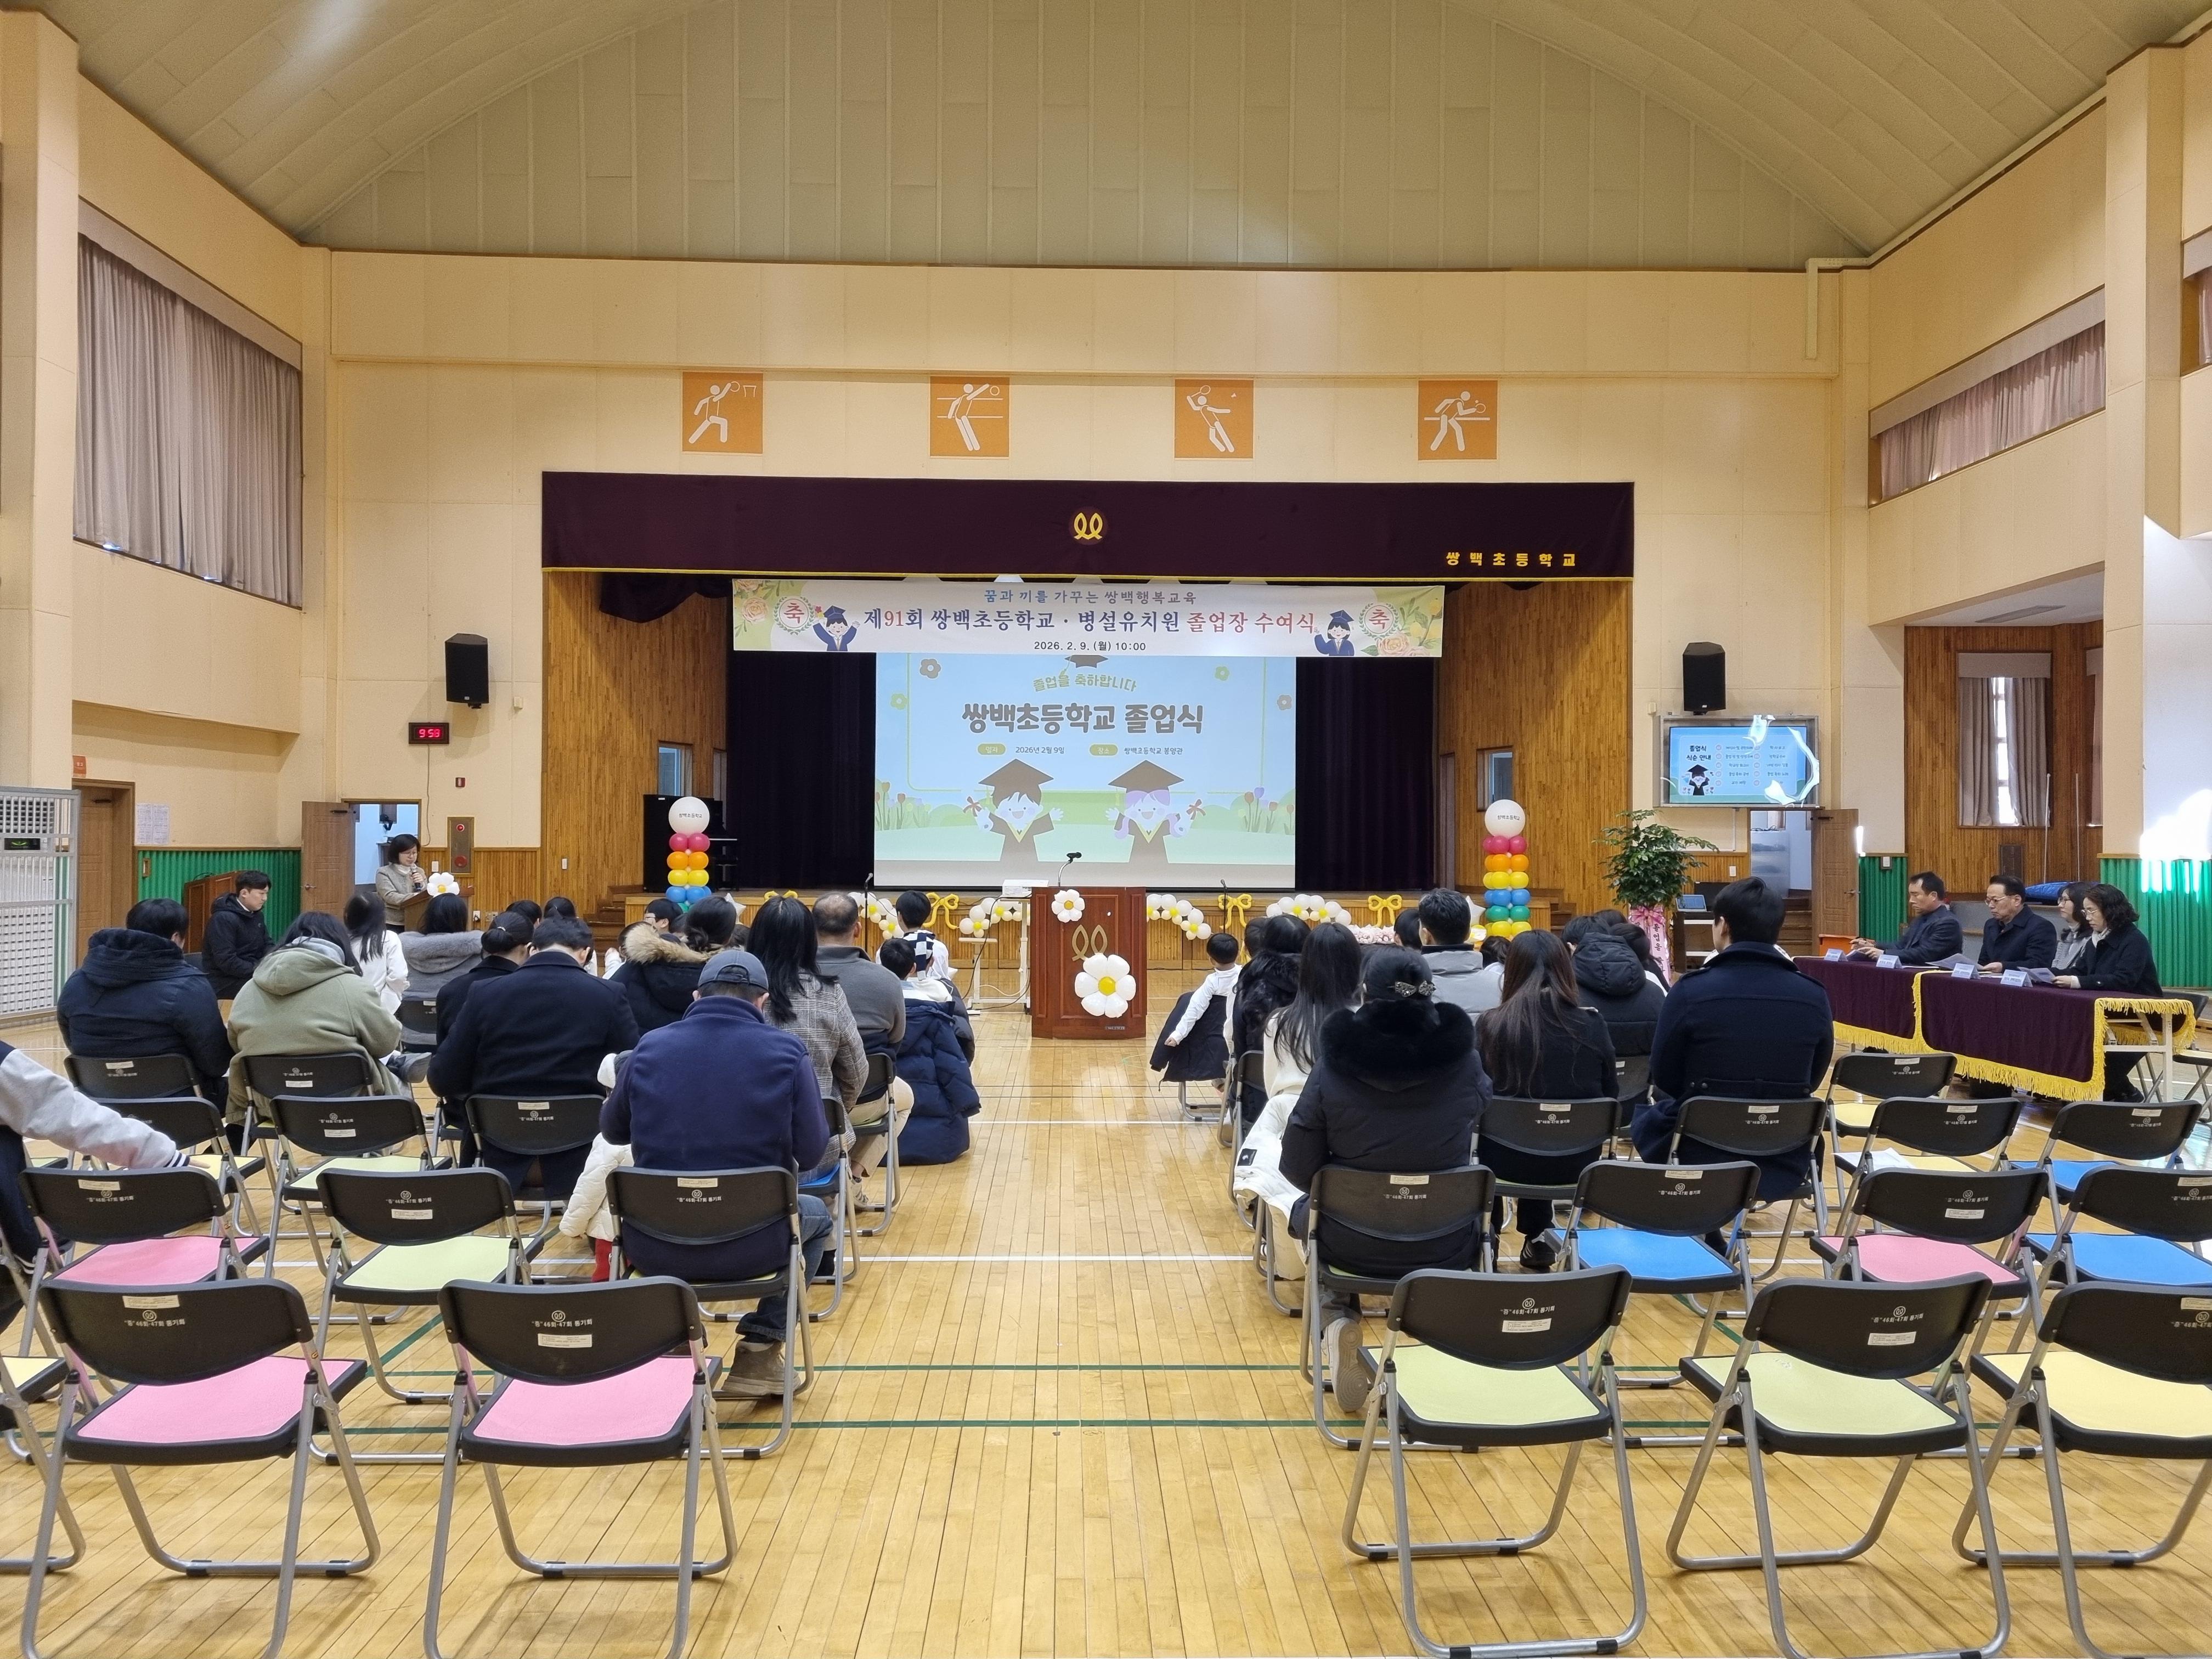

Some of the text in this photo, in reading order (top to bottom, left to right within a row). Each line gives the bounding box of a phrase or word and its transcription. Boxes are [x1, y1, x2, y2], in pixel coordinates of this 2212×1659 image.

[984, 590, 1197, 605] 꿈과 끼를 가꾸는 쌍백행복교육
[783, 602, 804, 624] 축
[864, 608, 1314, 634] 제91회 쌍백초등학교 병설유치원 졸업장 수여식
[1369, 608, 1390, 629] 축
[1093, 641, 1111, 652] (월)
[1116, 642, 1146, 651] 10:00
[1033, 674, 1137, 692] 졸업을 축하합니다
[962, 702, 1203, 734] 쌍백초등학교 졸업식
